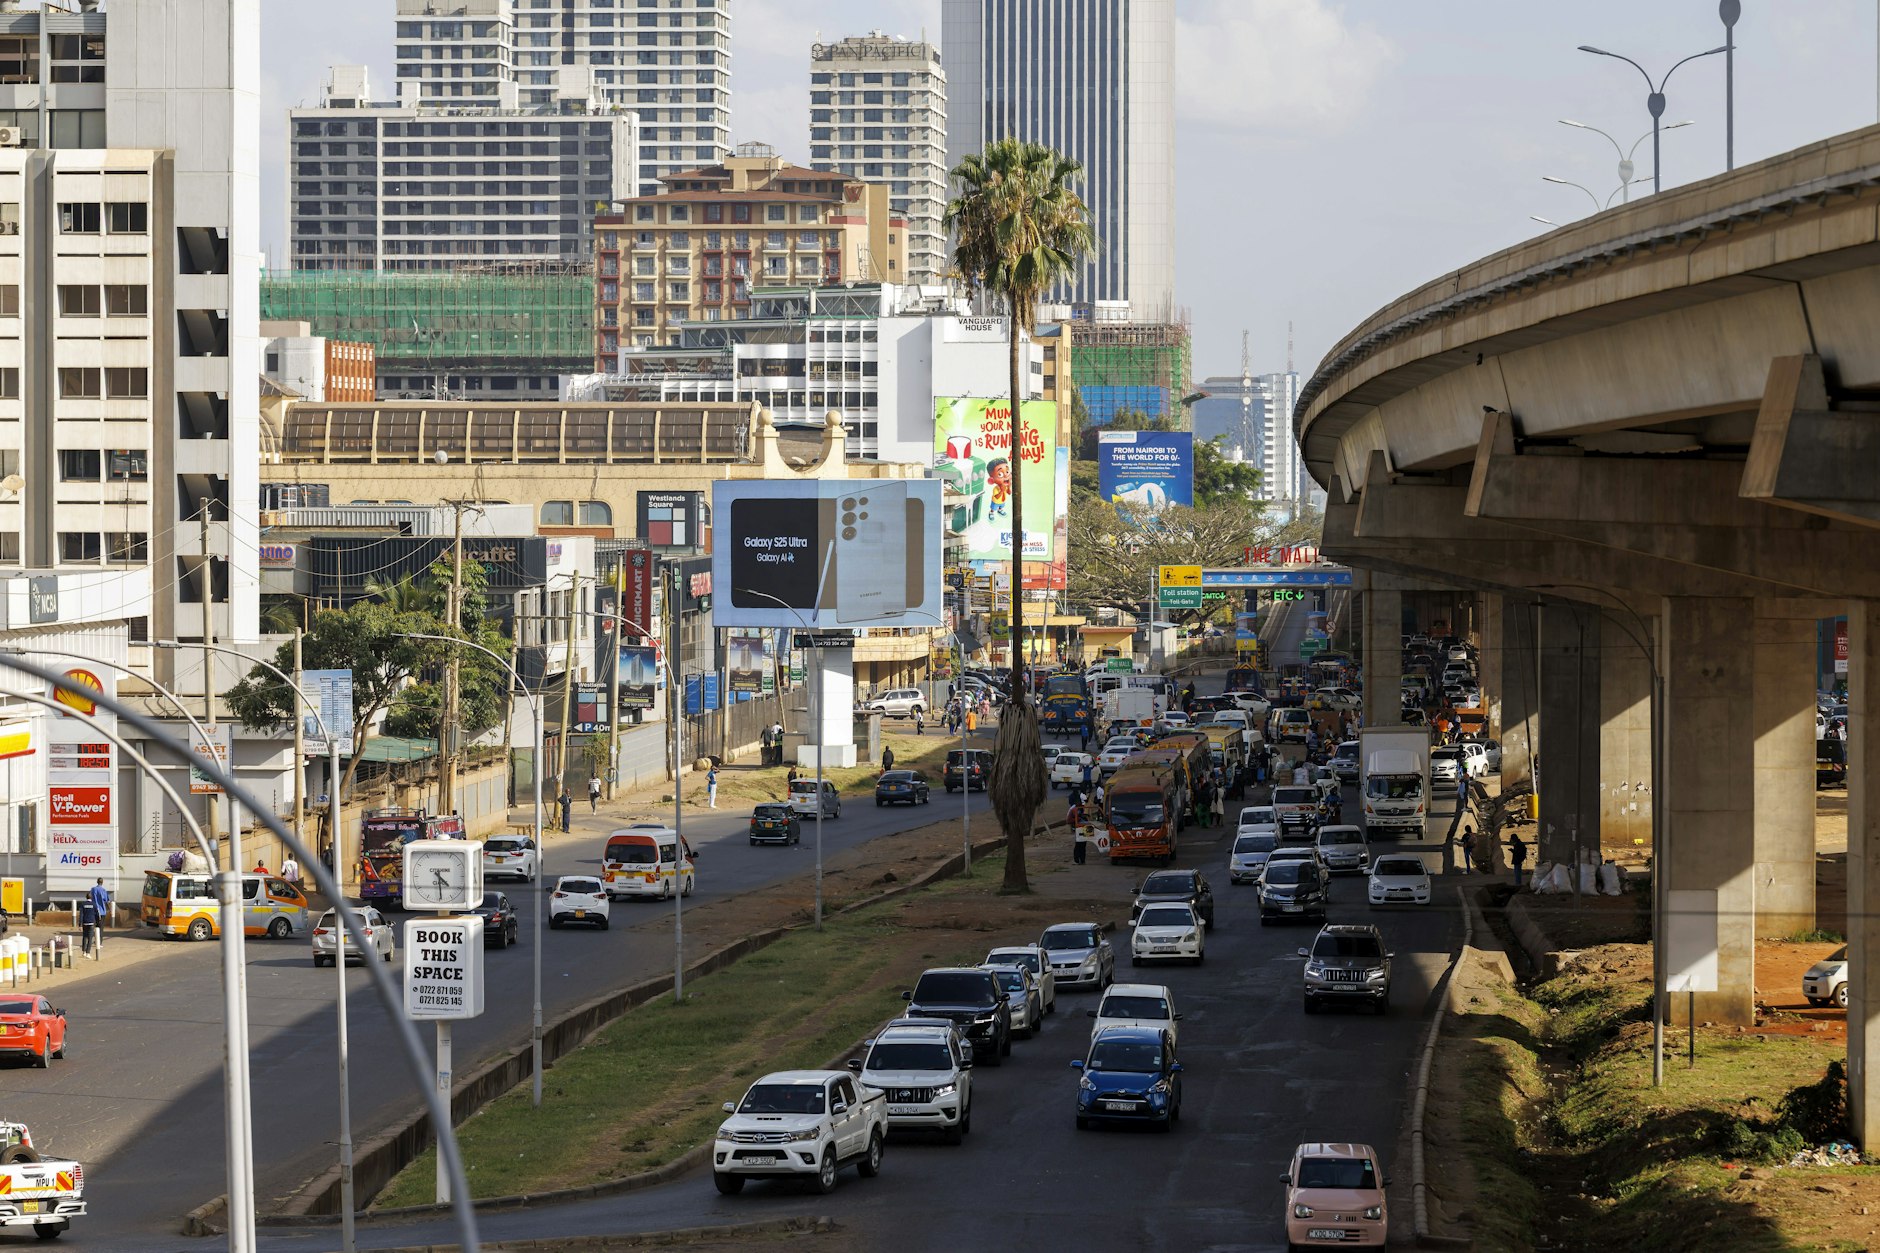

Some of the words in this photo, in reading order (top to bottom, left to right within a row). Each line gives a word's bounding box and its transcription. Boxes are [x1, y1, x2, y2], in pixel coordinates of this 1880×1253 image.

[830, 45, 858, 58] PAN
[864, 45, 921, 58] PACIFIC
[975, 438, 983, 447] IS
[744, 537, 773, 550] Galaxy
[774, 537, 787, 547] S25
[789, 537, 807, 547] Ultra
[757, 553, 780, 564] Galaxy
[780, 553, 787, 561] AI
[1244, 547, 1271, 563] THE
[1280, 547, 1321, 563] MALL
[1274, 592, 1293, 600] ETC
[42, 594, 57, 614] NCBA
[54, 802, 105, 812] V-Power
[61, 852, 101, 866] Afrigas
[416, 931, 463, 944] BOOK
[421, 949, 457, 962] THIS
[414, 967, 463, 980] SPACE
[420, 986, 435, 994] 0722
[437, 986, 448, 994] 871
[449, 987, 462, 995] 059
[420, 996, 434, 1004] 0721
[436, 996, 449, 1005] 825
[451, 997, 462, 1005] 145
[36, 1178, 49, 1187] MPU
[52, 1178, 54, 1186] 1
